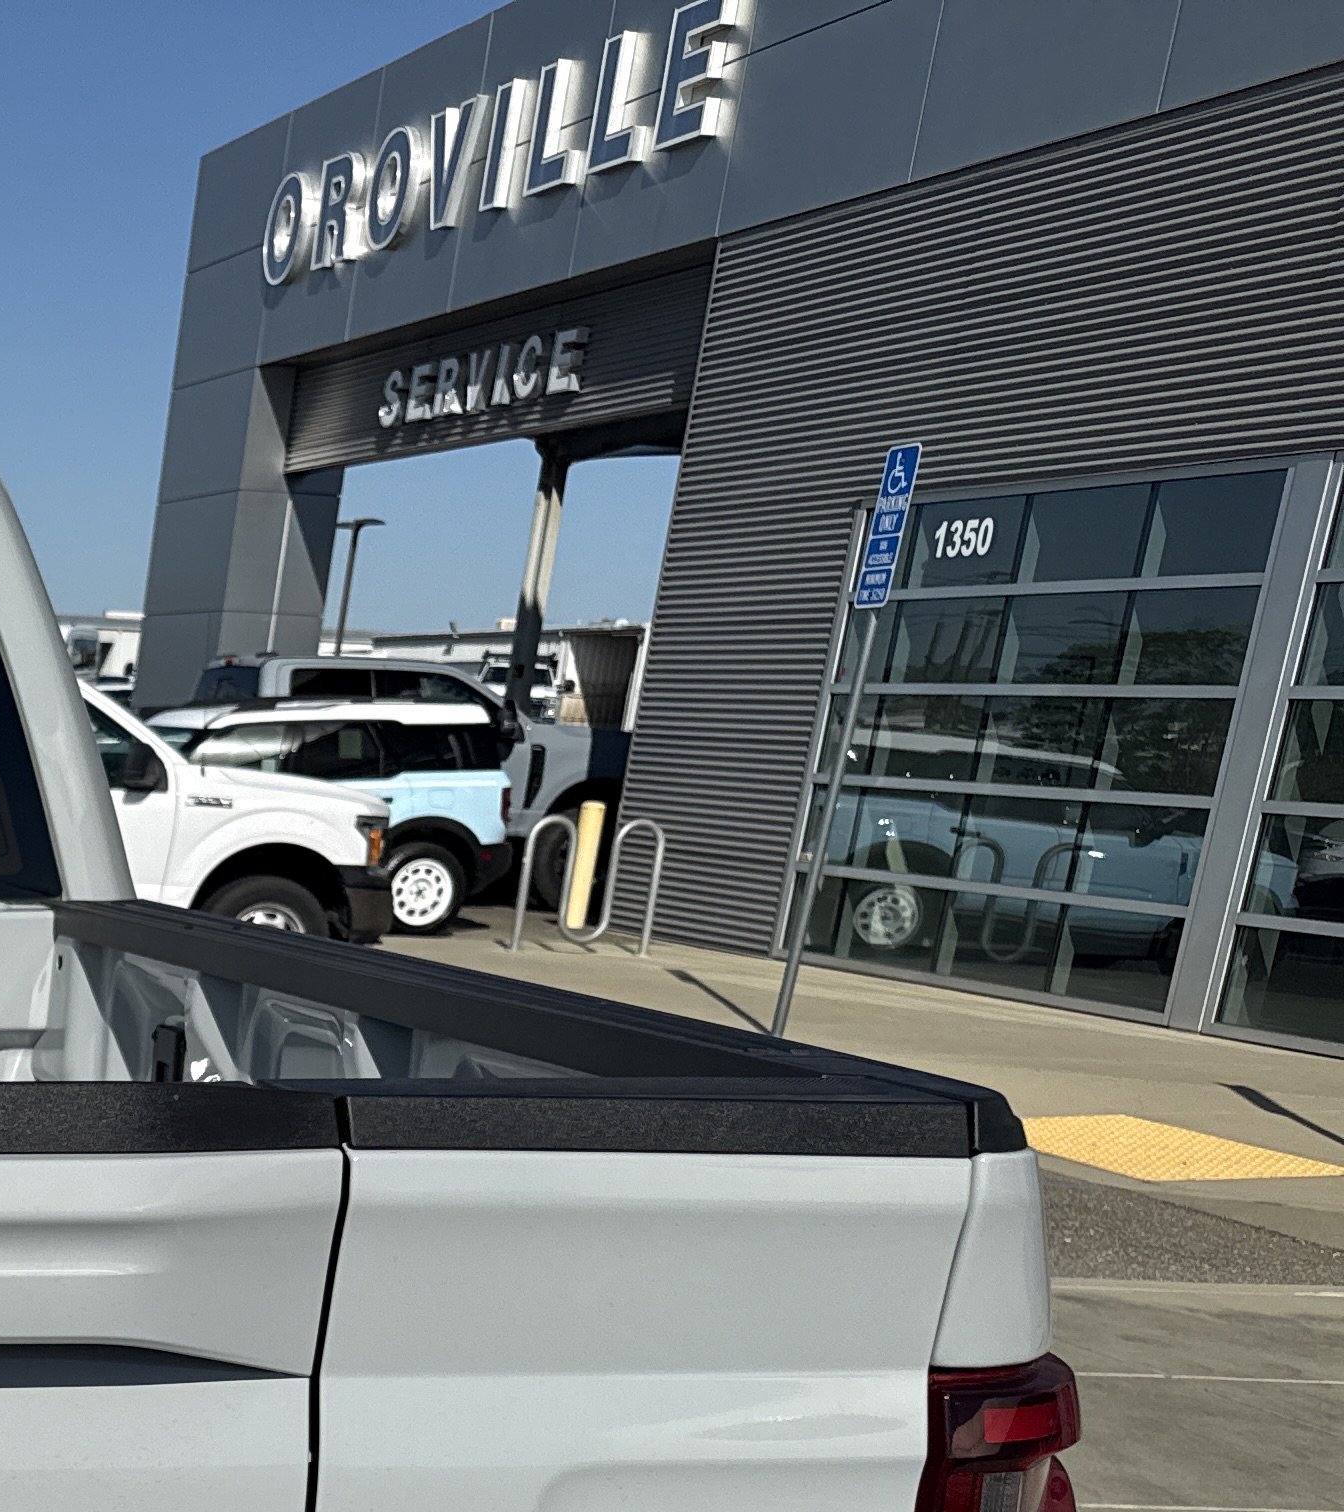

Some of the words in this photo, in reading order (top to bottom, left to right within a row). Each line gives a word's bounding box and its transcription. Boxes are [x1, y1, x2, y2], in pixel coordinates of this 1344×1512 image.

[263, 0, 737, 286] OROVILLE
[377, 326, 590, 429] SERVICE
[934, 517, 994, 559] 1350
